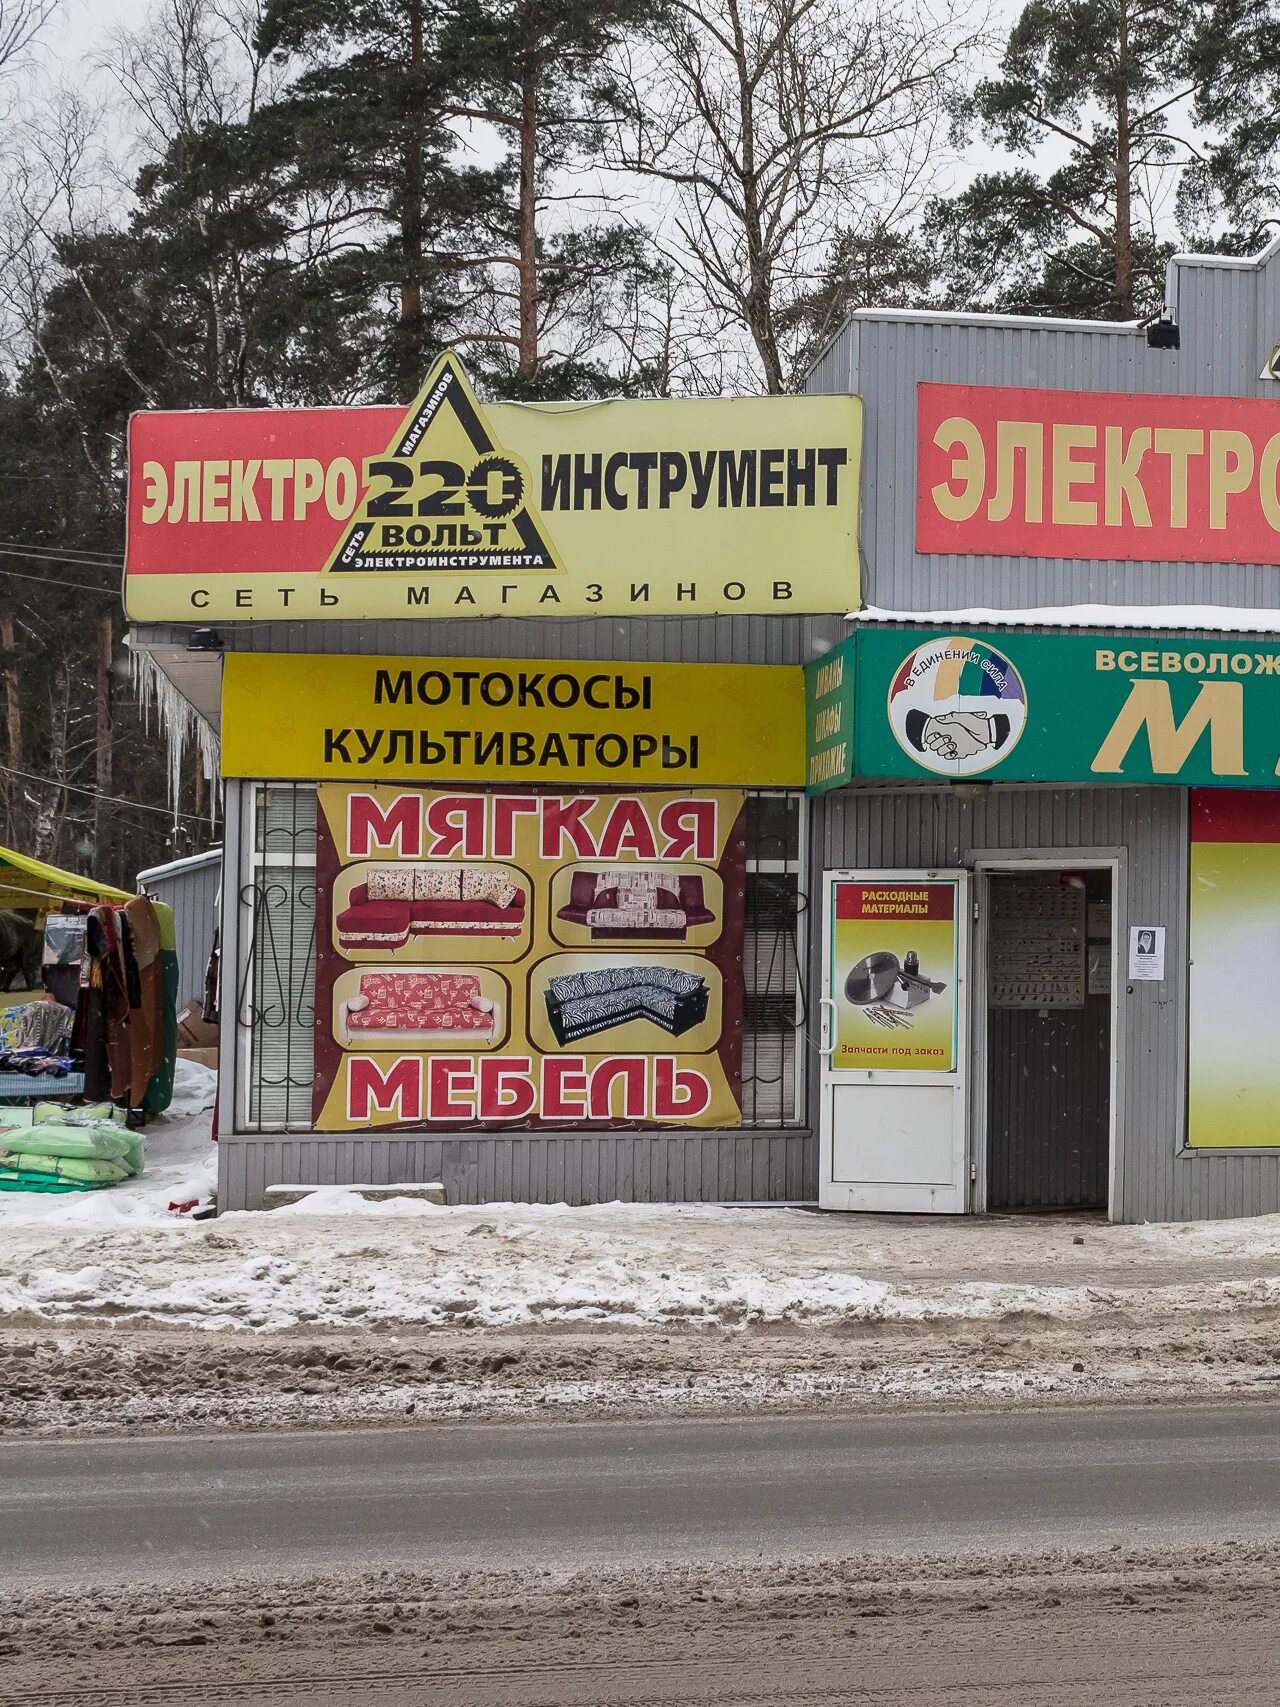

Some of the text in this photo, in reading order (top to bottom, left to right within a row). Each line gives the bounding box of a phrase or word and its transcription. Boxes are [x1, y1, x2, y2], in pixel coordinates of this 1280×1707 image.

[401, 373, 453, 455] МАГАЗИНОВ
[141, 447, 848, 525] ЭЛЕКТРО 220 ИНСТРУМЕНТ
[341, 530, 365, 563] СЕТЬ
[381, 523, 506, 547] ВОЛЬТ
[355, 555, 543, 568] ЭЛЕКТРОИНСТРУМЕНТА
[191, 580, 794, 608] СЕТЬ МАГАЗИНОВ
[374, 669, 652, 710] МОТОКОСЫ
[905, 650, 1007, 692] В ЕДИНЕНИИ СИЛА
[816, 702, 841, 742] ШКАФЫ
[324, 729, 699, 769] КУЛЬТИВАТОРЫ
[810, 742, 846, 784] ПРИХОЖИЕ
[347, 793, 718, 861] МЯГКАЯ
[861, 891, 929, 902] РАСХОДНЫЕ
[861, 904, 928, 914] МАТЕРИАЛЫ
[841, 1044, 944, 1056] Запчасти под заказ
[347, 1056, 712, 1121] МЕБЕЛЬ
